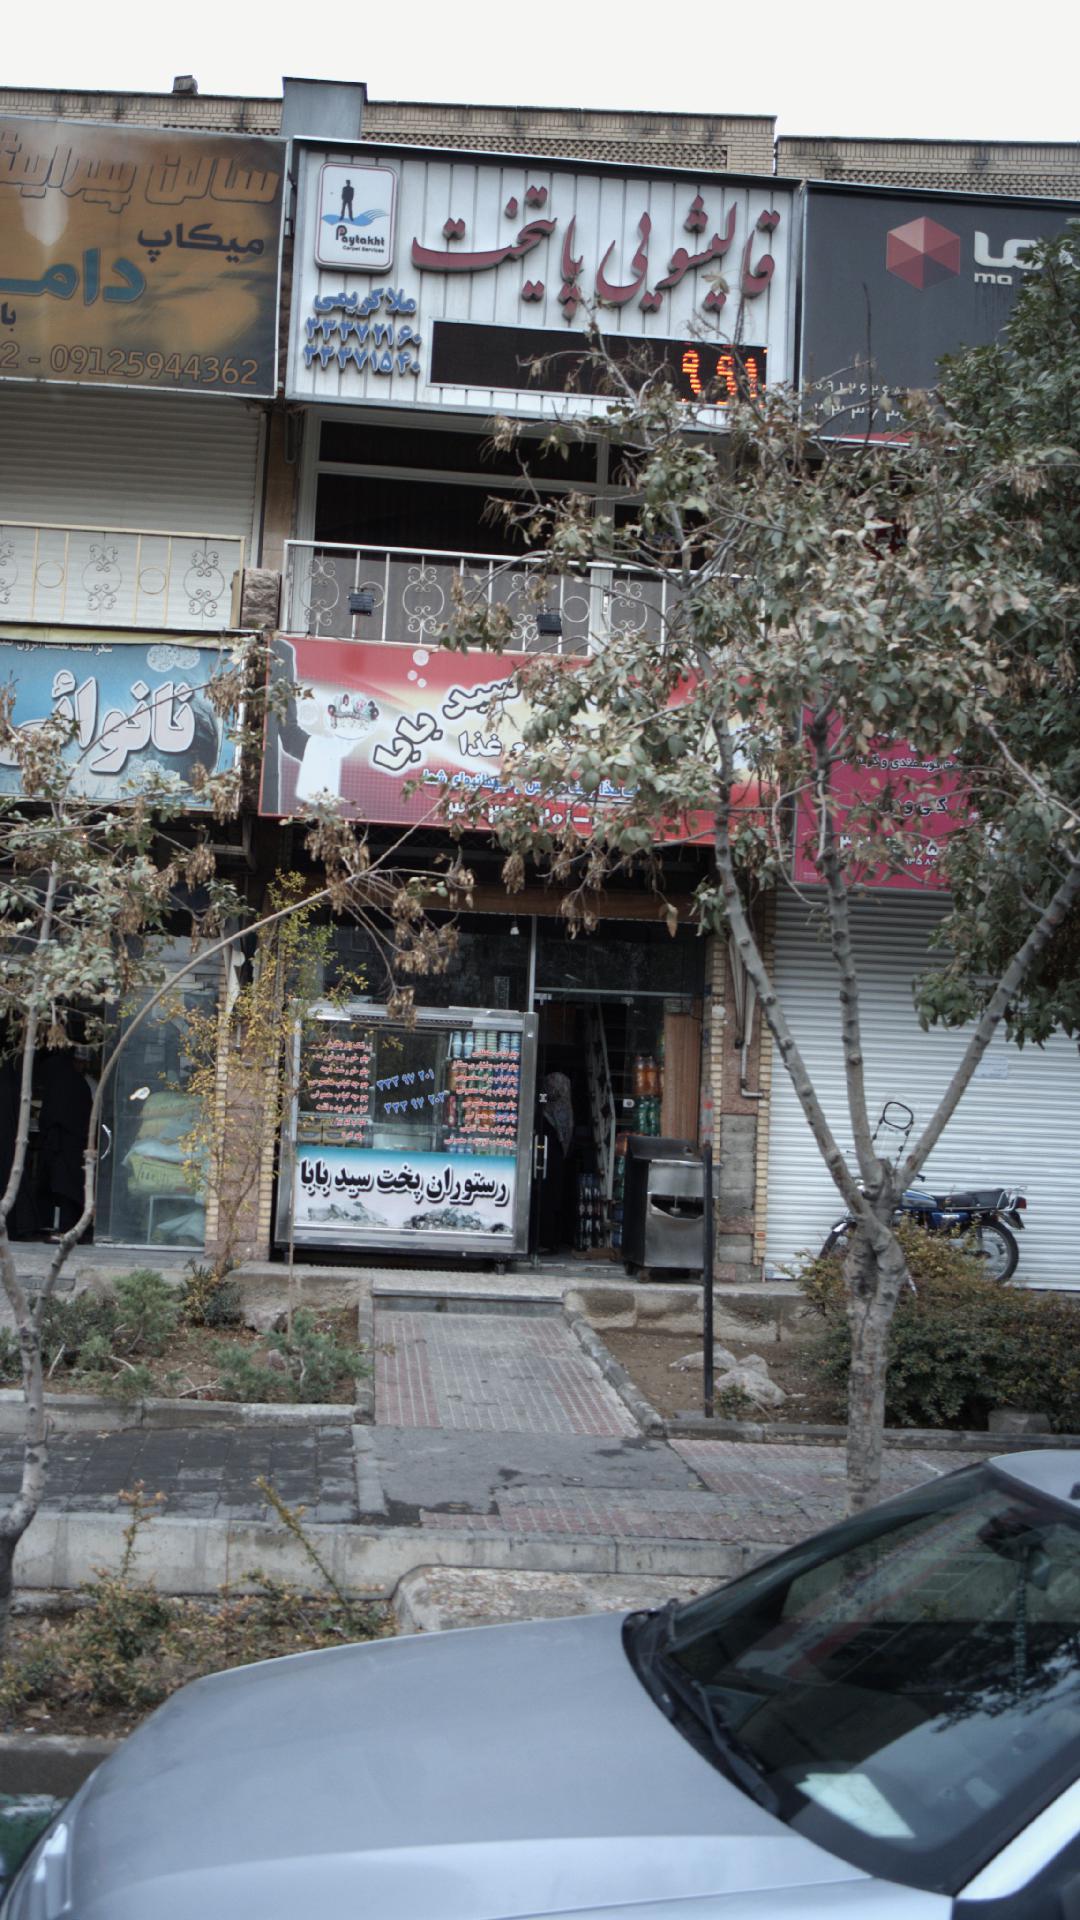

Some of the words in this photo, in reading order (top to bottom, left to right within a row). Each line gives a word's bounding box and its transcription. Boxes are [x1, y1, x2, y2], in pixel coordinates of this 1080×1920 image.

[137, 223, 265, 262] میکاپ
[336, 225, 385, 246] Paytakht
[411, 184, 584, 321] پایتخت
[597, 195, 781, 314] قالیشویی
[51, 345, 258, 386] 09125944362
[458, 730, 503, 756] غذا
[300, 1158, 332, 1195] بابا
[334, 1167, 373, 1199] سید
[376, 1163, 424, 1204] پخت
[426, 1166, 511, 1206] رستوران
